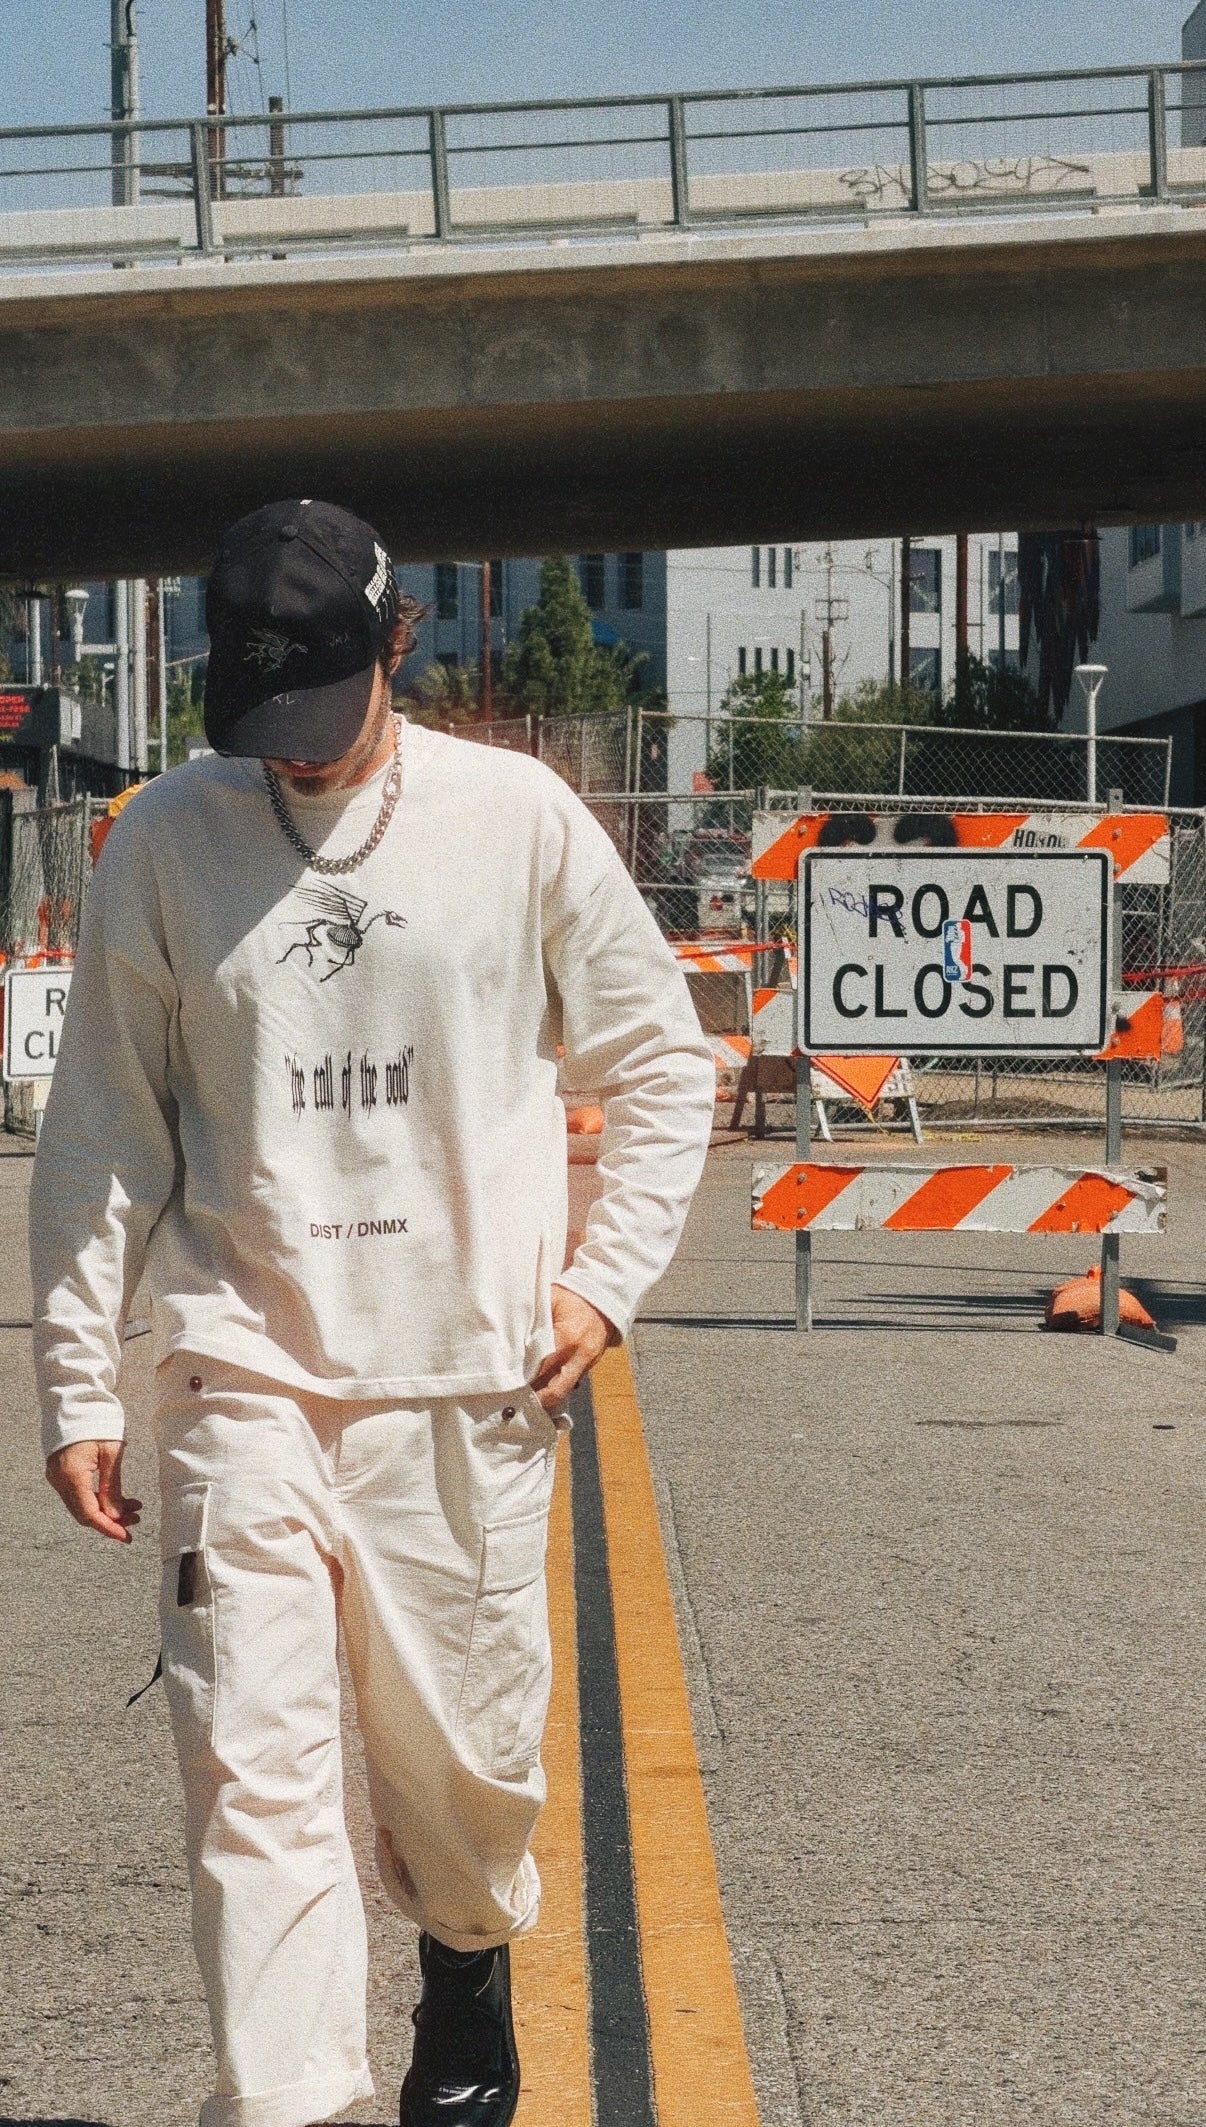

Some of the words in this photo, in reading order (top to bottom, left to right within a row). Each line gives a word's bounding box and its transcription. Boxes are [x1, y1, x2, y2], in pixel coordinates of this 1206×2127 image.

[868, 884, 1043, 938] ROAD
[832, 963, 1079, 1018] CLOSED
[314, 1052, 334, 1112] call
[342, 1049, 352, 1121] of
[360, 1048, 378, 1120] the
[309, 1222, 343, 1239] DIST
[357, 1218, 409, 1238] DNMX
